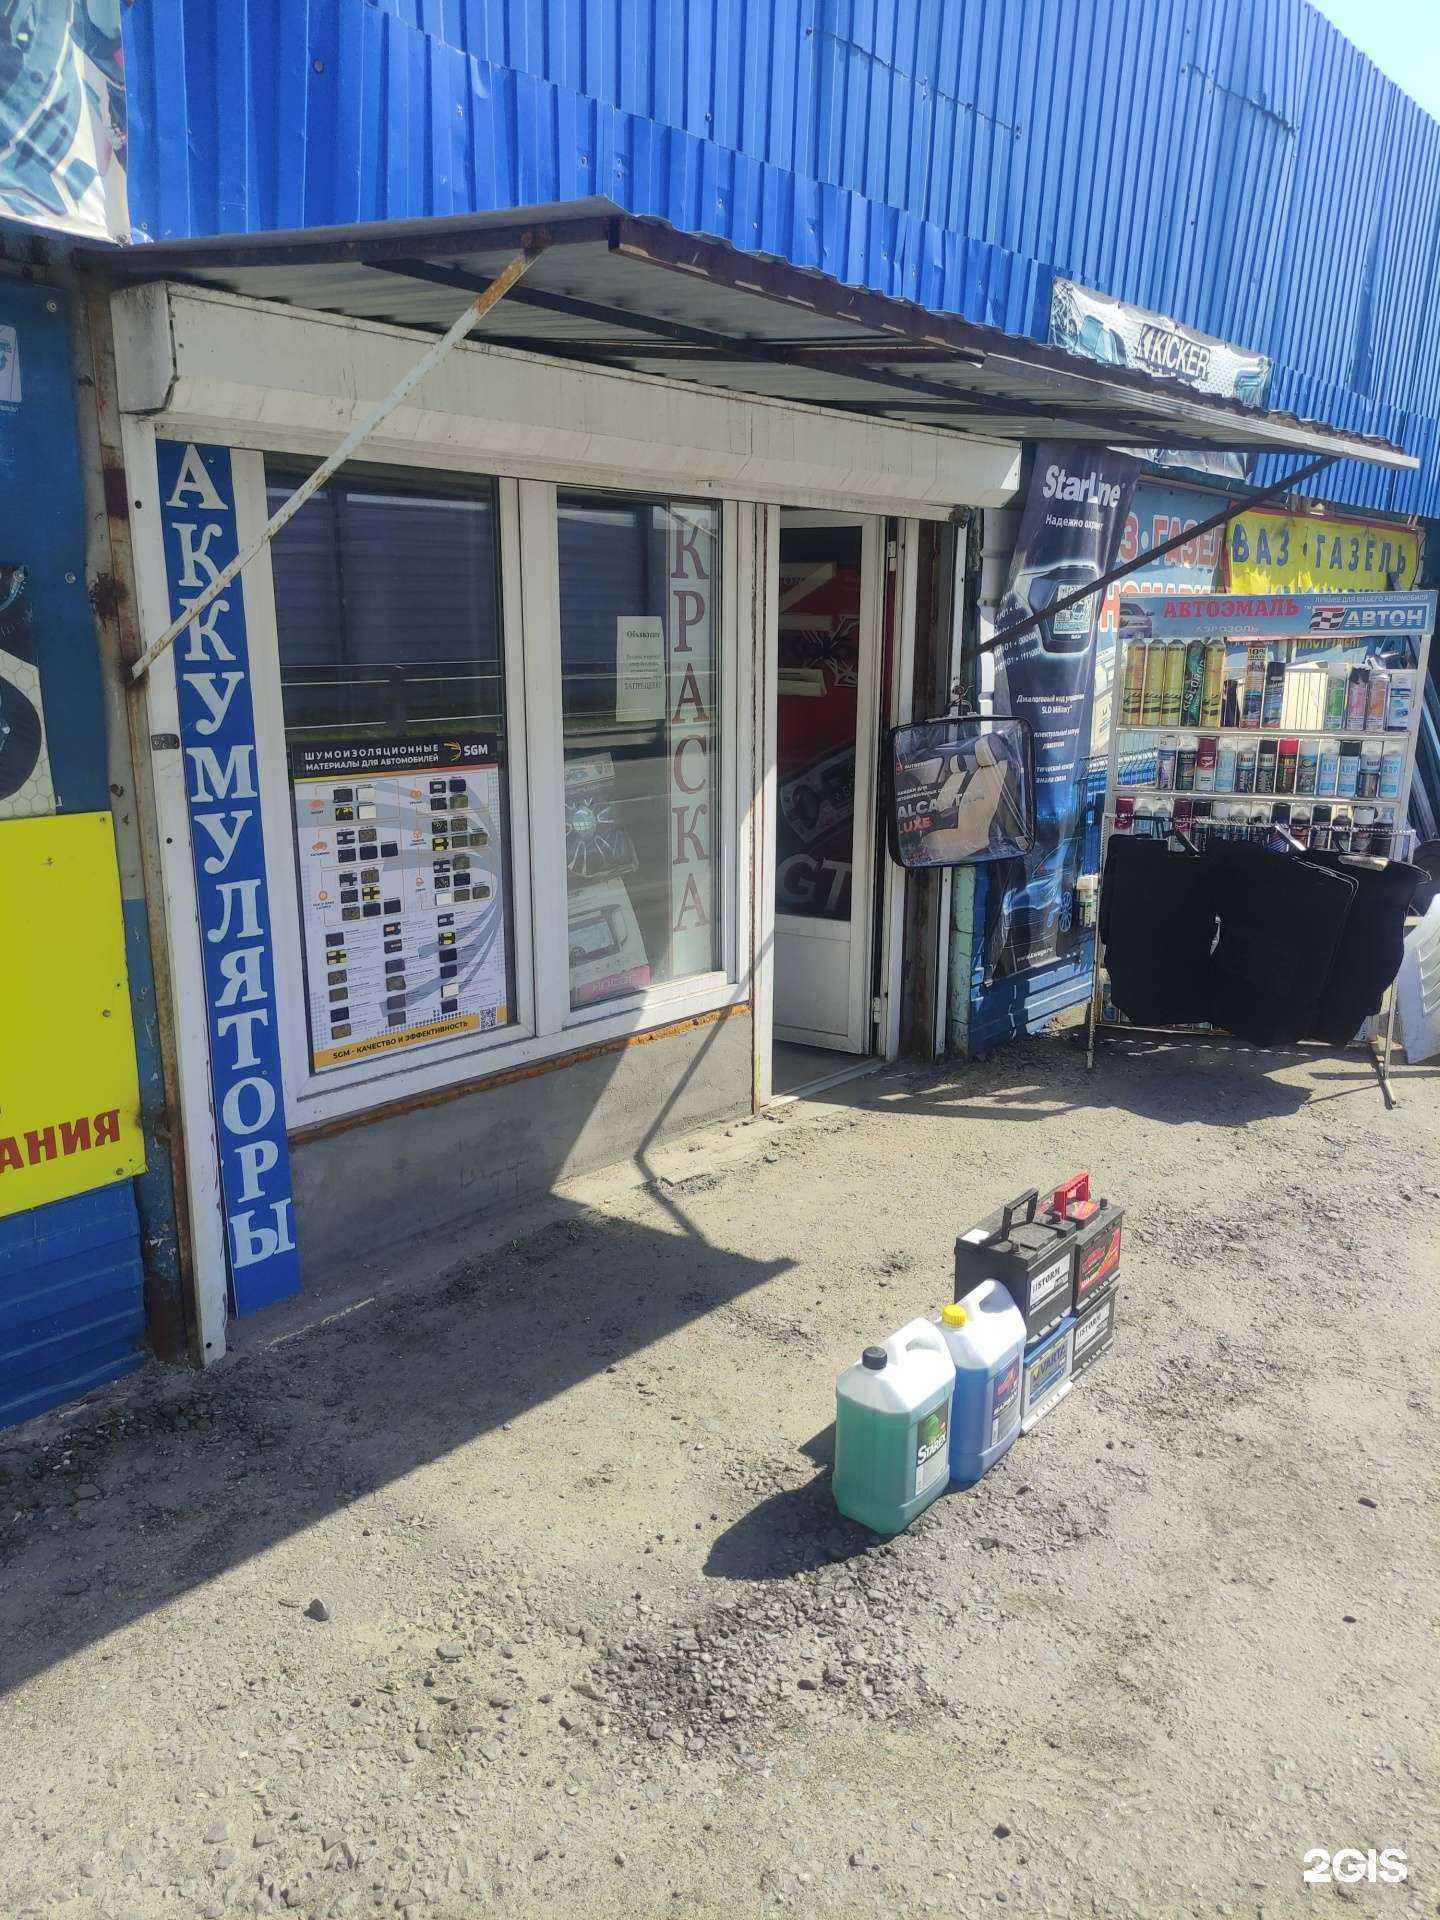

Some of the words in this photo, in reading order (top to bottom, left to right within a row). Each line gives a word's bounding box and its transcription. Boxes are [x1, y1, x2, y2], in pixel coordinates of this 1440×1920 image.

[1151, 328, 1211, 380] KICKER
[1046, 514, 1083, 529] Надежно
[1231, 521, 1290, 568] ВАЗ
[1314, 533, 1406, 576] ГАЗЕЛЬ
[1162, 598, 1300, 619] АВТОЭМАЛЬ
[1344, 609, 1423, 627] АВТОН
[670, 518, 711, 933] КРАСКА
[304, 743, 439, 761] ШУМОИЗОЛЯЦИОННЫЕ
[464, 744, 488, 757] SGM
[305, 758, 360, 771] МАТЕРИАЛЫ
[361, 756, 379, 769] ДЛЯ
[380, 754, 439, 767] АВТОМОБИЛЕЙ
[165, 443, 297, 1269] АККУМУЛЯТОРЫ
[333, 1048, 350, 1060] SGM
[356, 1038, 397, 1054] КАЧЕСТВО
[405, 1021, 468, 1042] ЭФФЕКТИВНОСТЬ
